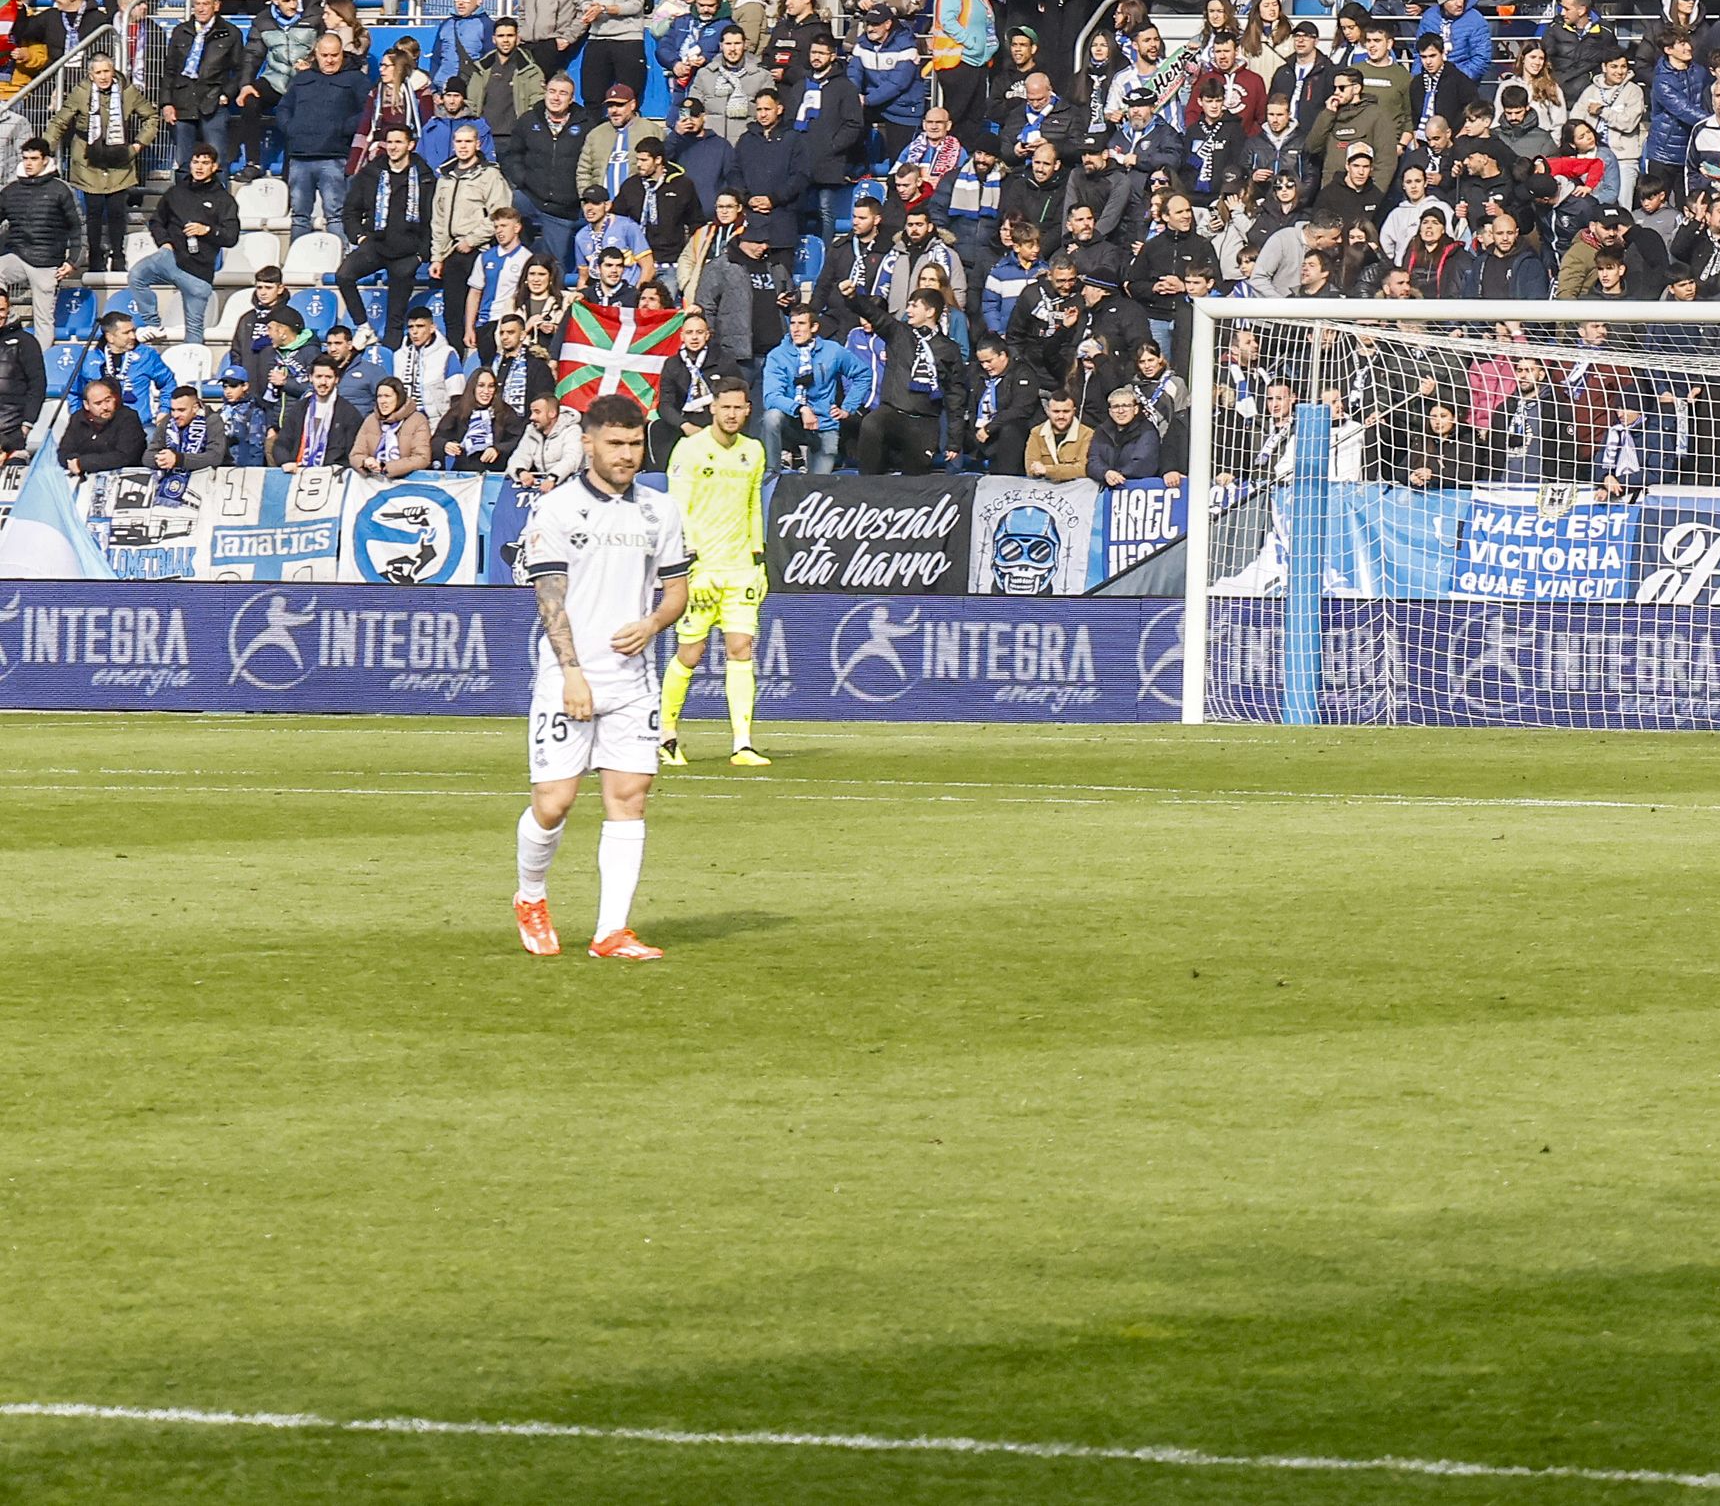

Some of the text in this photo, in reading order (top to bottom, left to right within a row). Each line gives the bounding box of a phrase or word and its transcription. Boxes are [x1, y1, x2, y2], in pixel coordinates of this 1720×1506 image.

[777, 491, 960, 541] Alaveszale
[1110, 487, 1181, 543] HAEC
[1471, 509, 1630, 538] HAEC EST
[784, 537, 952, 587] eta harro
[1467, 540, 1622, 571] VICTORIA
[1460, 570, 1619, 599] QUAE VINCIT
[21, 607, 190, 665] INTEGRA
[319, 611, 490, 670] INTEGRA
[923, 621, 1095, 683] INTEGRA
[536, 712, 568, 745] 25
